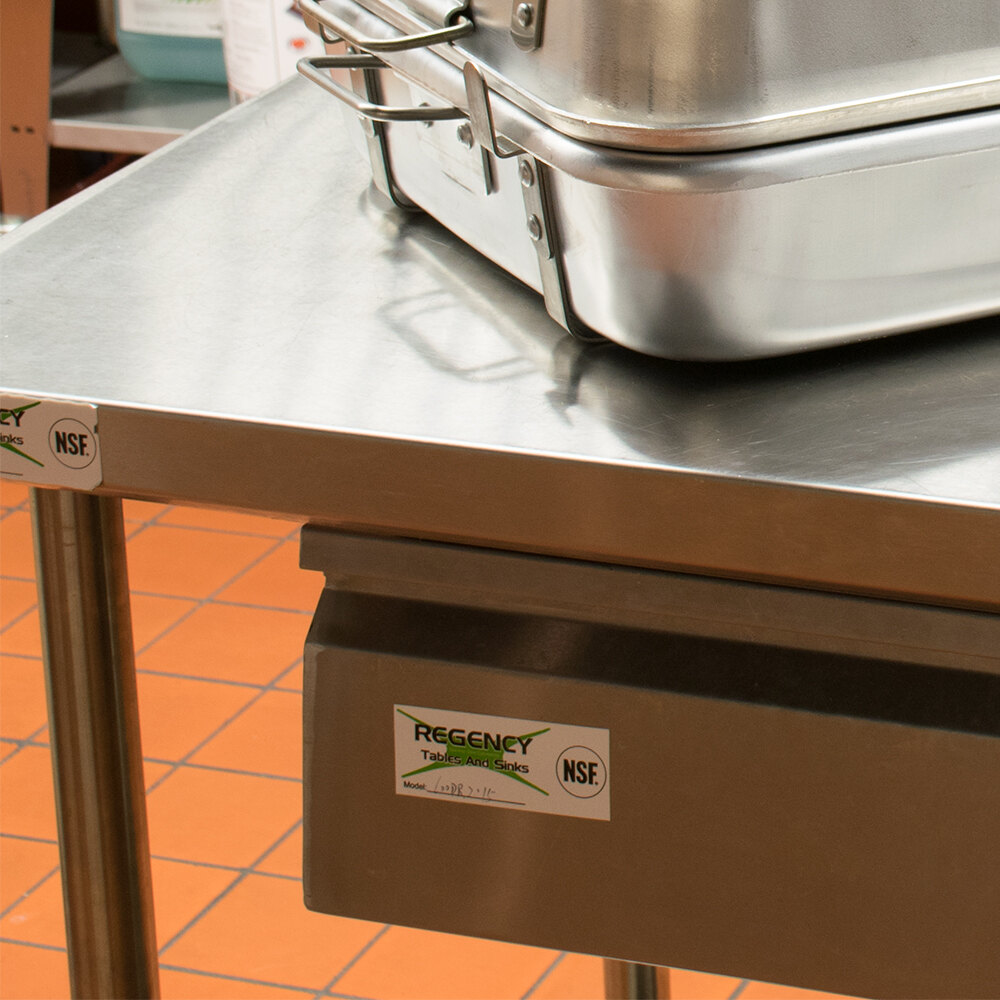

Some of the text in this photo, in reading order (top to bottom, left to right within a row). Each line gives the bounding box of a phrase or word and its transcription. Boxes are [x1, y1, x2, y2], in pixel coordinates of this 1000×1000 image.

[415, 724, 533, 755] REGENCY
[421, 750, 529, 774] Tables And Sinks
